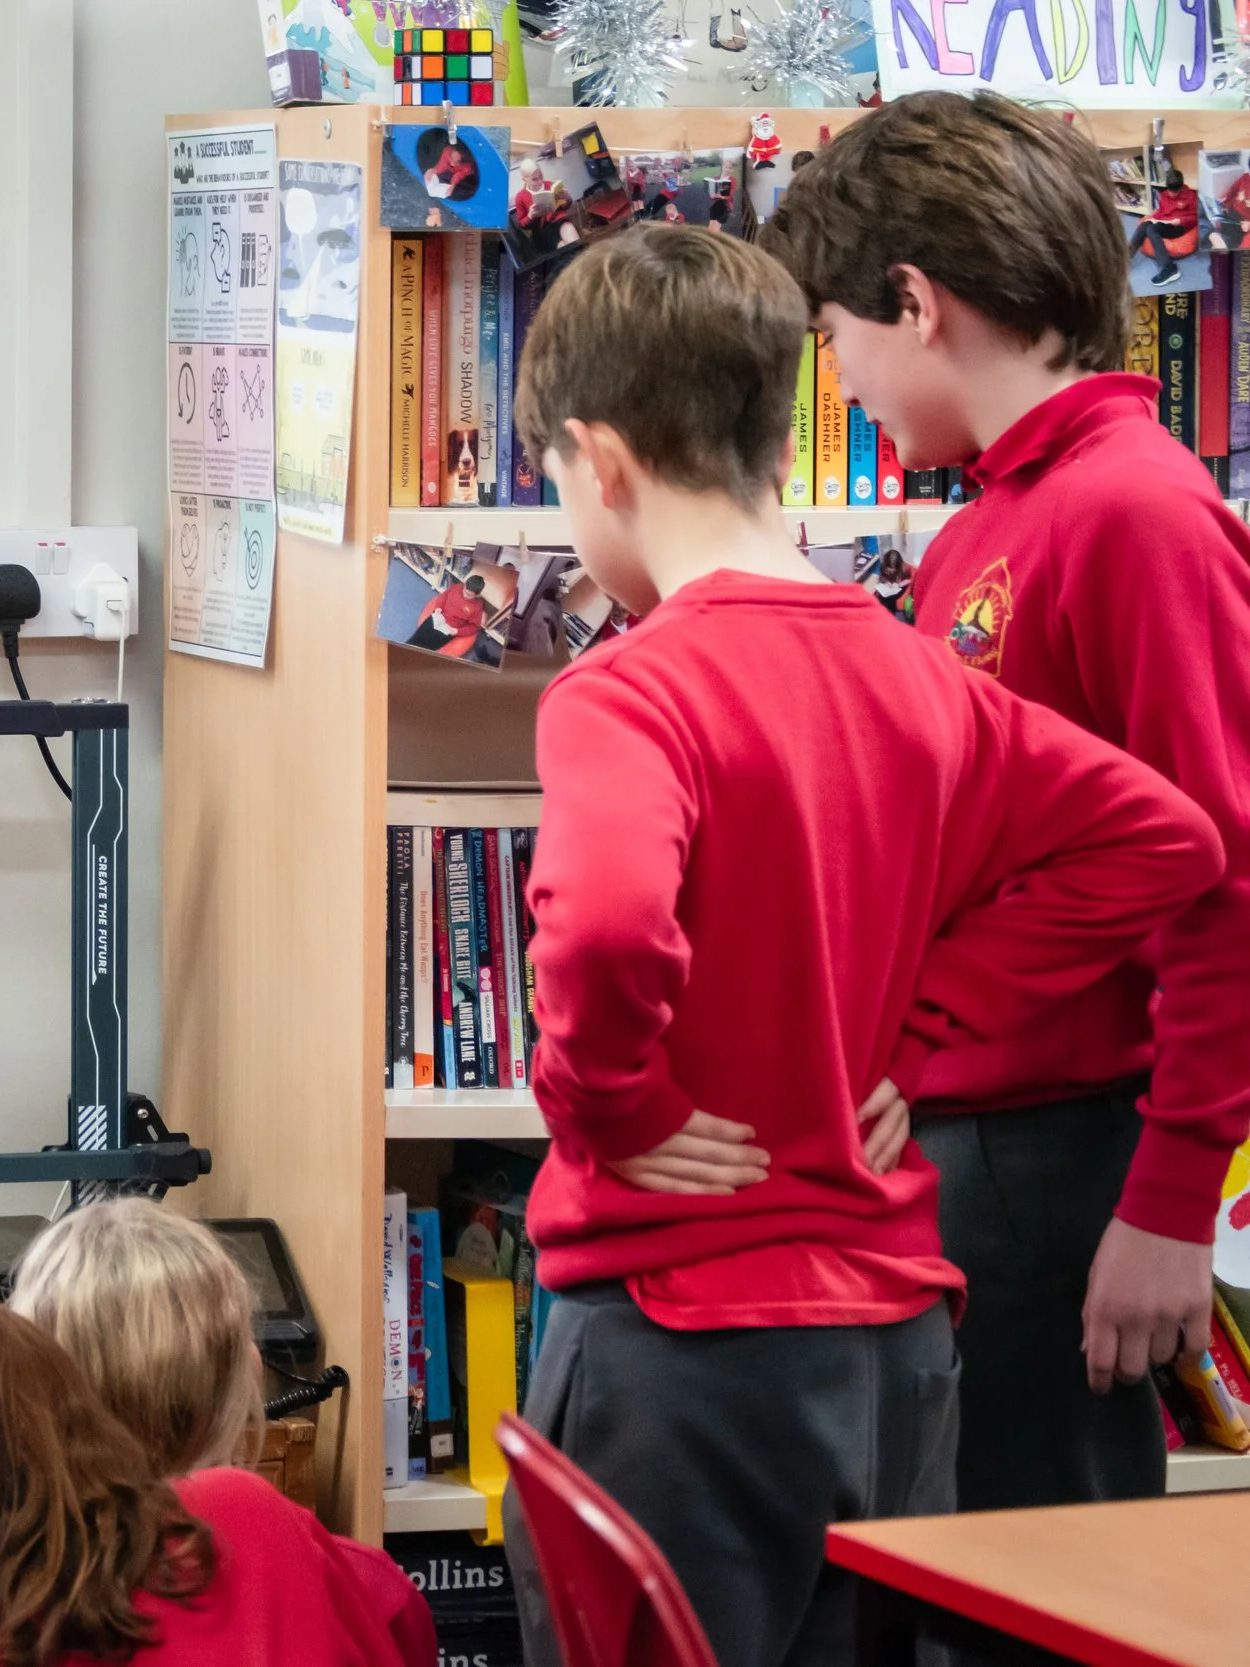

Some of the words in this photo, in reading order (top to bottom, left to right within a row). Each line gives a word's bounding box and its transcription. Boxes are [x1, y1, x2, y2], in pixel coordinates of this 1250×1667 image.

[464, 233, 479, 276] chael
[1238, 341, 1250, 372] AUDEN
[460, 361, 473, 424] SHADOW
[1170, 360, 1182, 401] DAVID
[1237, 374, 1250, 403] DARE
[799, 402, 807, 453] JAMES
[822, 392, 831, 463] DASHNER
[833, 402, 841, 453] JAMES
[401, 443, 411, 488] HARRISON
[450, 834, 464, 862] YOUNG
[473, 840, 483, 877] DEMON
[98, 855, 107, 899] CREATE
[399, 882, 409, 895] The
[448, 862, 471, 924] SHERLOCK
[97, 903, 107, 925] THE
[420, 891, 428, 909] Does
[418, 910, 429, 940] Anything
[475, 881, 488, 952] HEADMASTER
[97, 928, 107, 975] FUTURE
[420, 942, 429, 954] Eat
[454, 928, 469, 959] SNAKE
[418, 955, 429, 984] Wasps?
[456, 960, 472, 980] BITE
[459, 1002, 474, 1040] ANDREW
[484, 1020, 492, 1039] CROSS
[461, 1041, 476, 1062] LANE
[486, 1046, 494, 1075] OXFORD
[388, 1319, 403, 1380] DEMON
[399, 1559, 504, 1591] ollins
